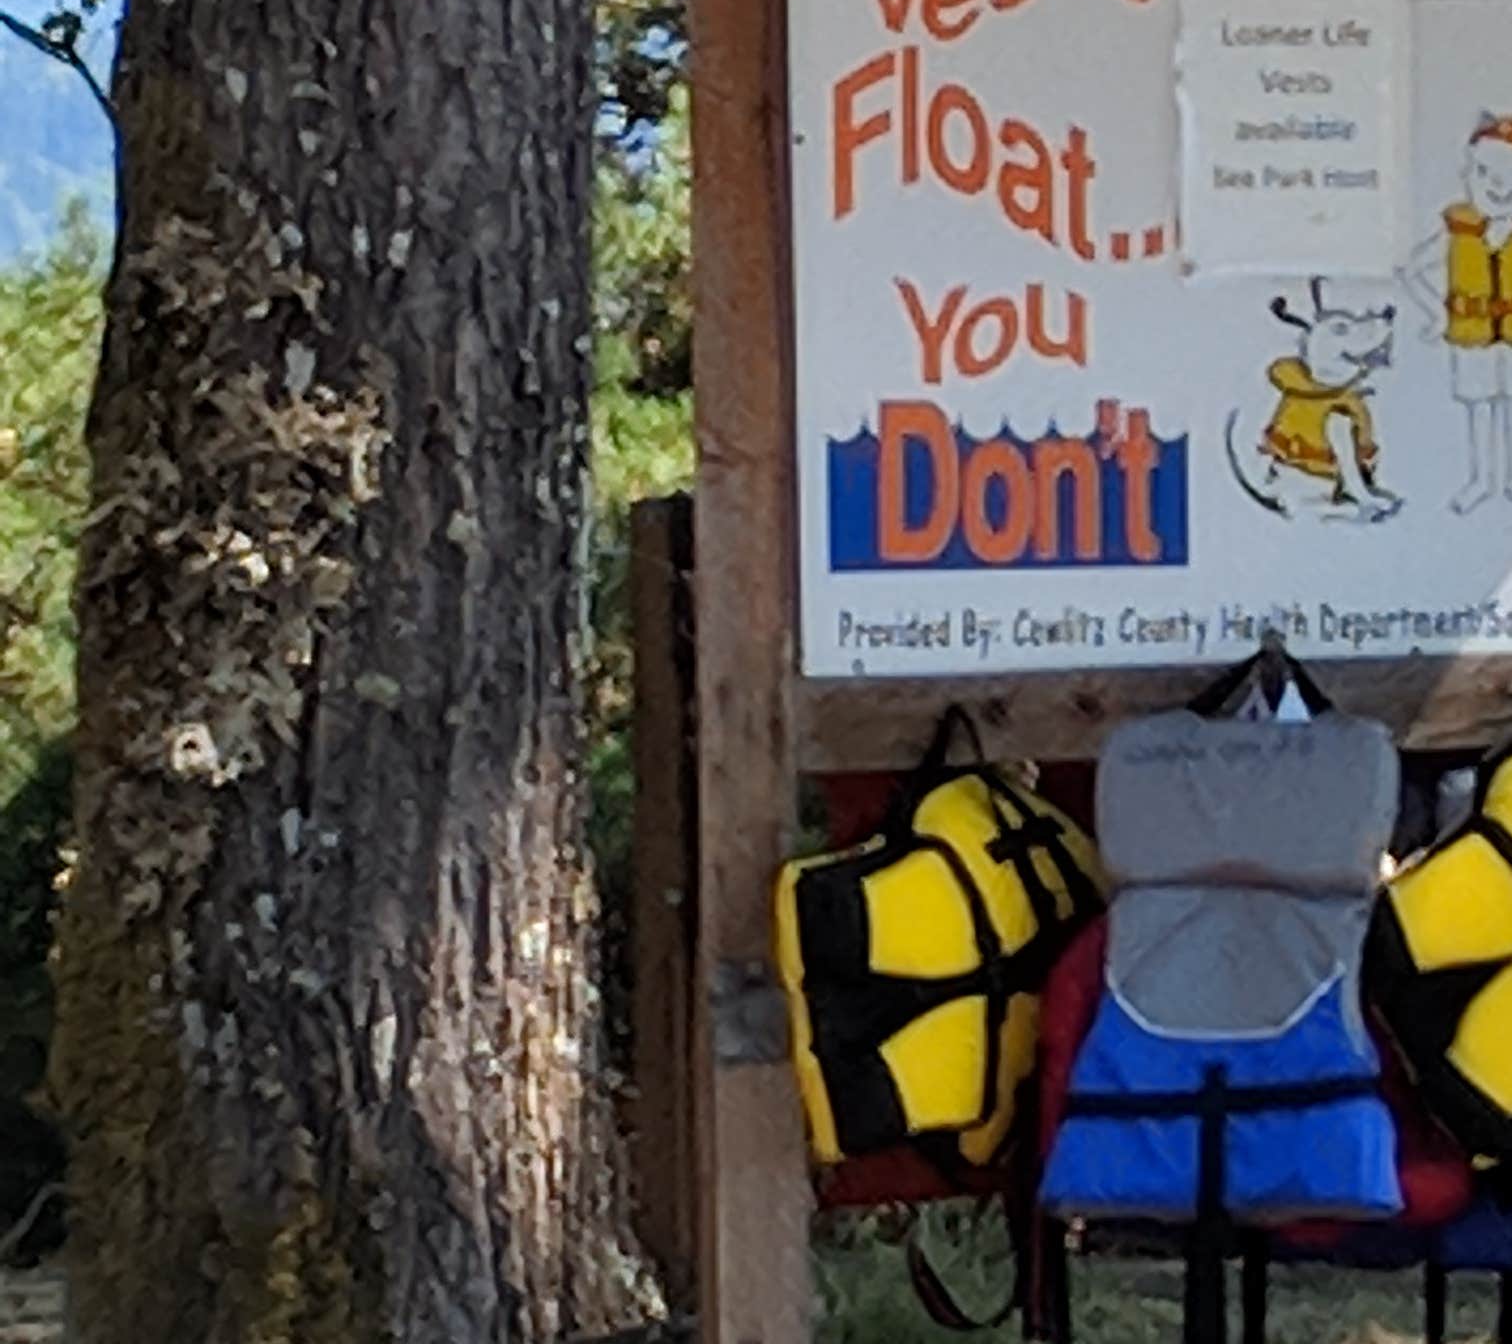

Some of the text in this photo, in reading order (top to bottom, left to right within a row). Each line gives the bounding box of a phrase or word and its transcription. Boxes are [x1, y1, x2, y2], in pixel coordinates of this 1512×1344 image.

[833, 45, 1182, 261] Float..
[893, 276, 1088, 386] You
[877, 398, 1163, 564] Don't
[838, 608, 951, 649] Provided
[1118, 605, 1210, 657] County
